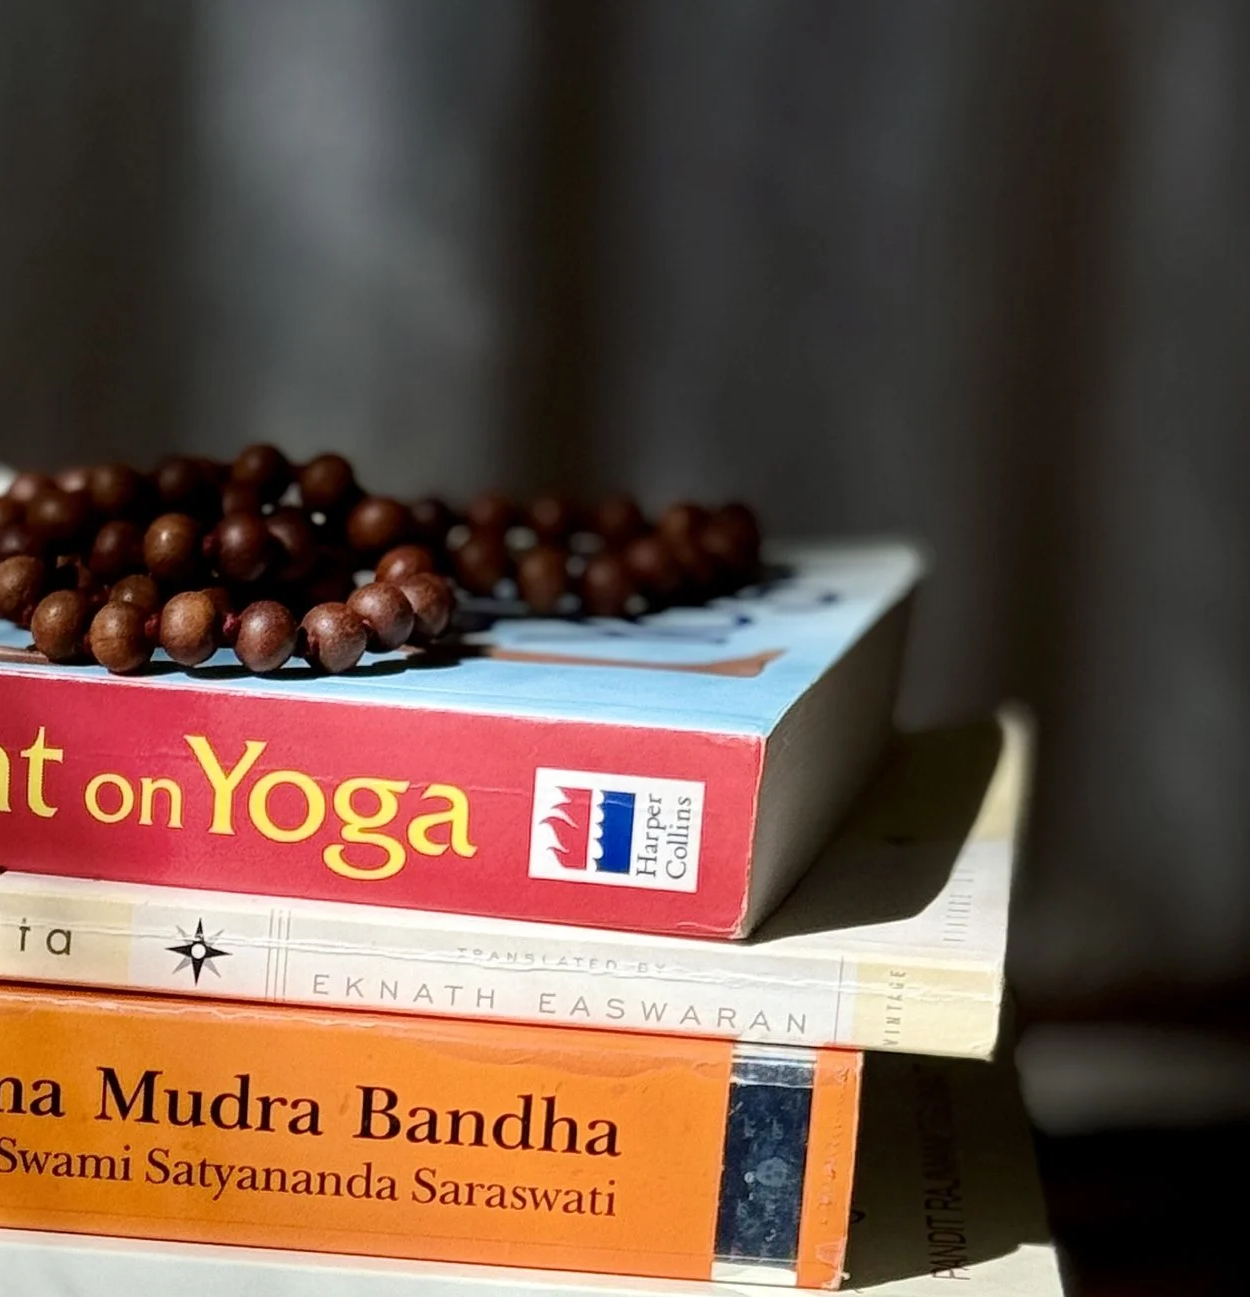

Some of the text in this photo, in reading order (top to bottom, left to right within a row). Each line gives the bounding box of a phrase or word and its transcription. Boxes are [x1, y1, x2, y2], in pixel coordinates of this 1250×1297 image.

[84, 773, 184, 829] on
[184, 735, 477, 881] Yoga
[635, 793, 666, 877] Harper
[666, 796, 692, 880] Collins
[312, 973, 808, 1035] EKNATH EASWARAN
[882, 969, 907, 1046] VINTAGE
[94, 1065, 323, 1136] Mudra
[352, 1085, 622, 1157] Bandha
[144, 1148, 399, 1202] Satyananda
[410, 1167, 617, 1217] Saraswati
